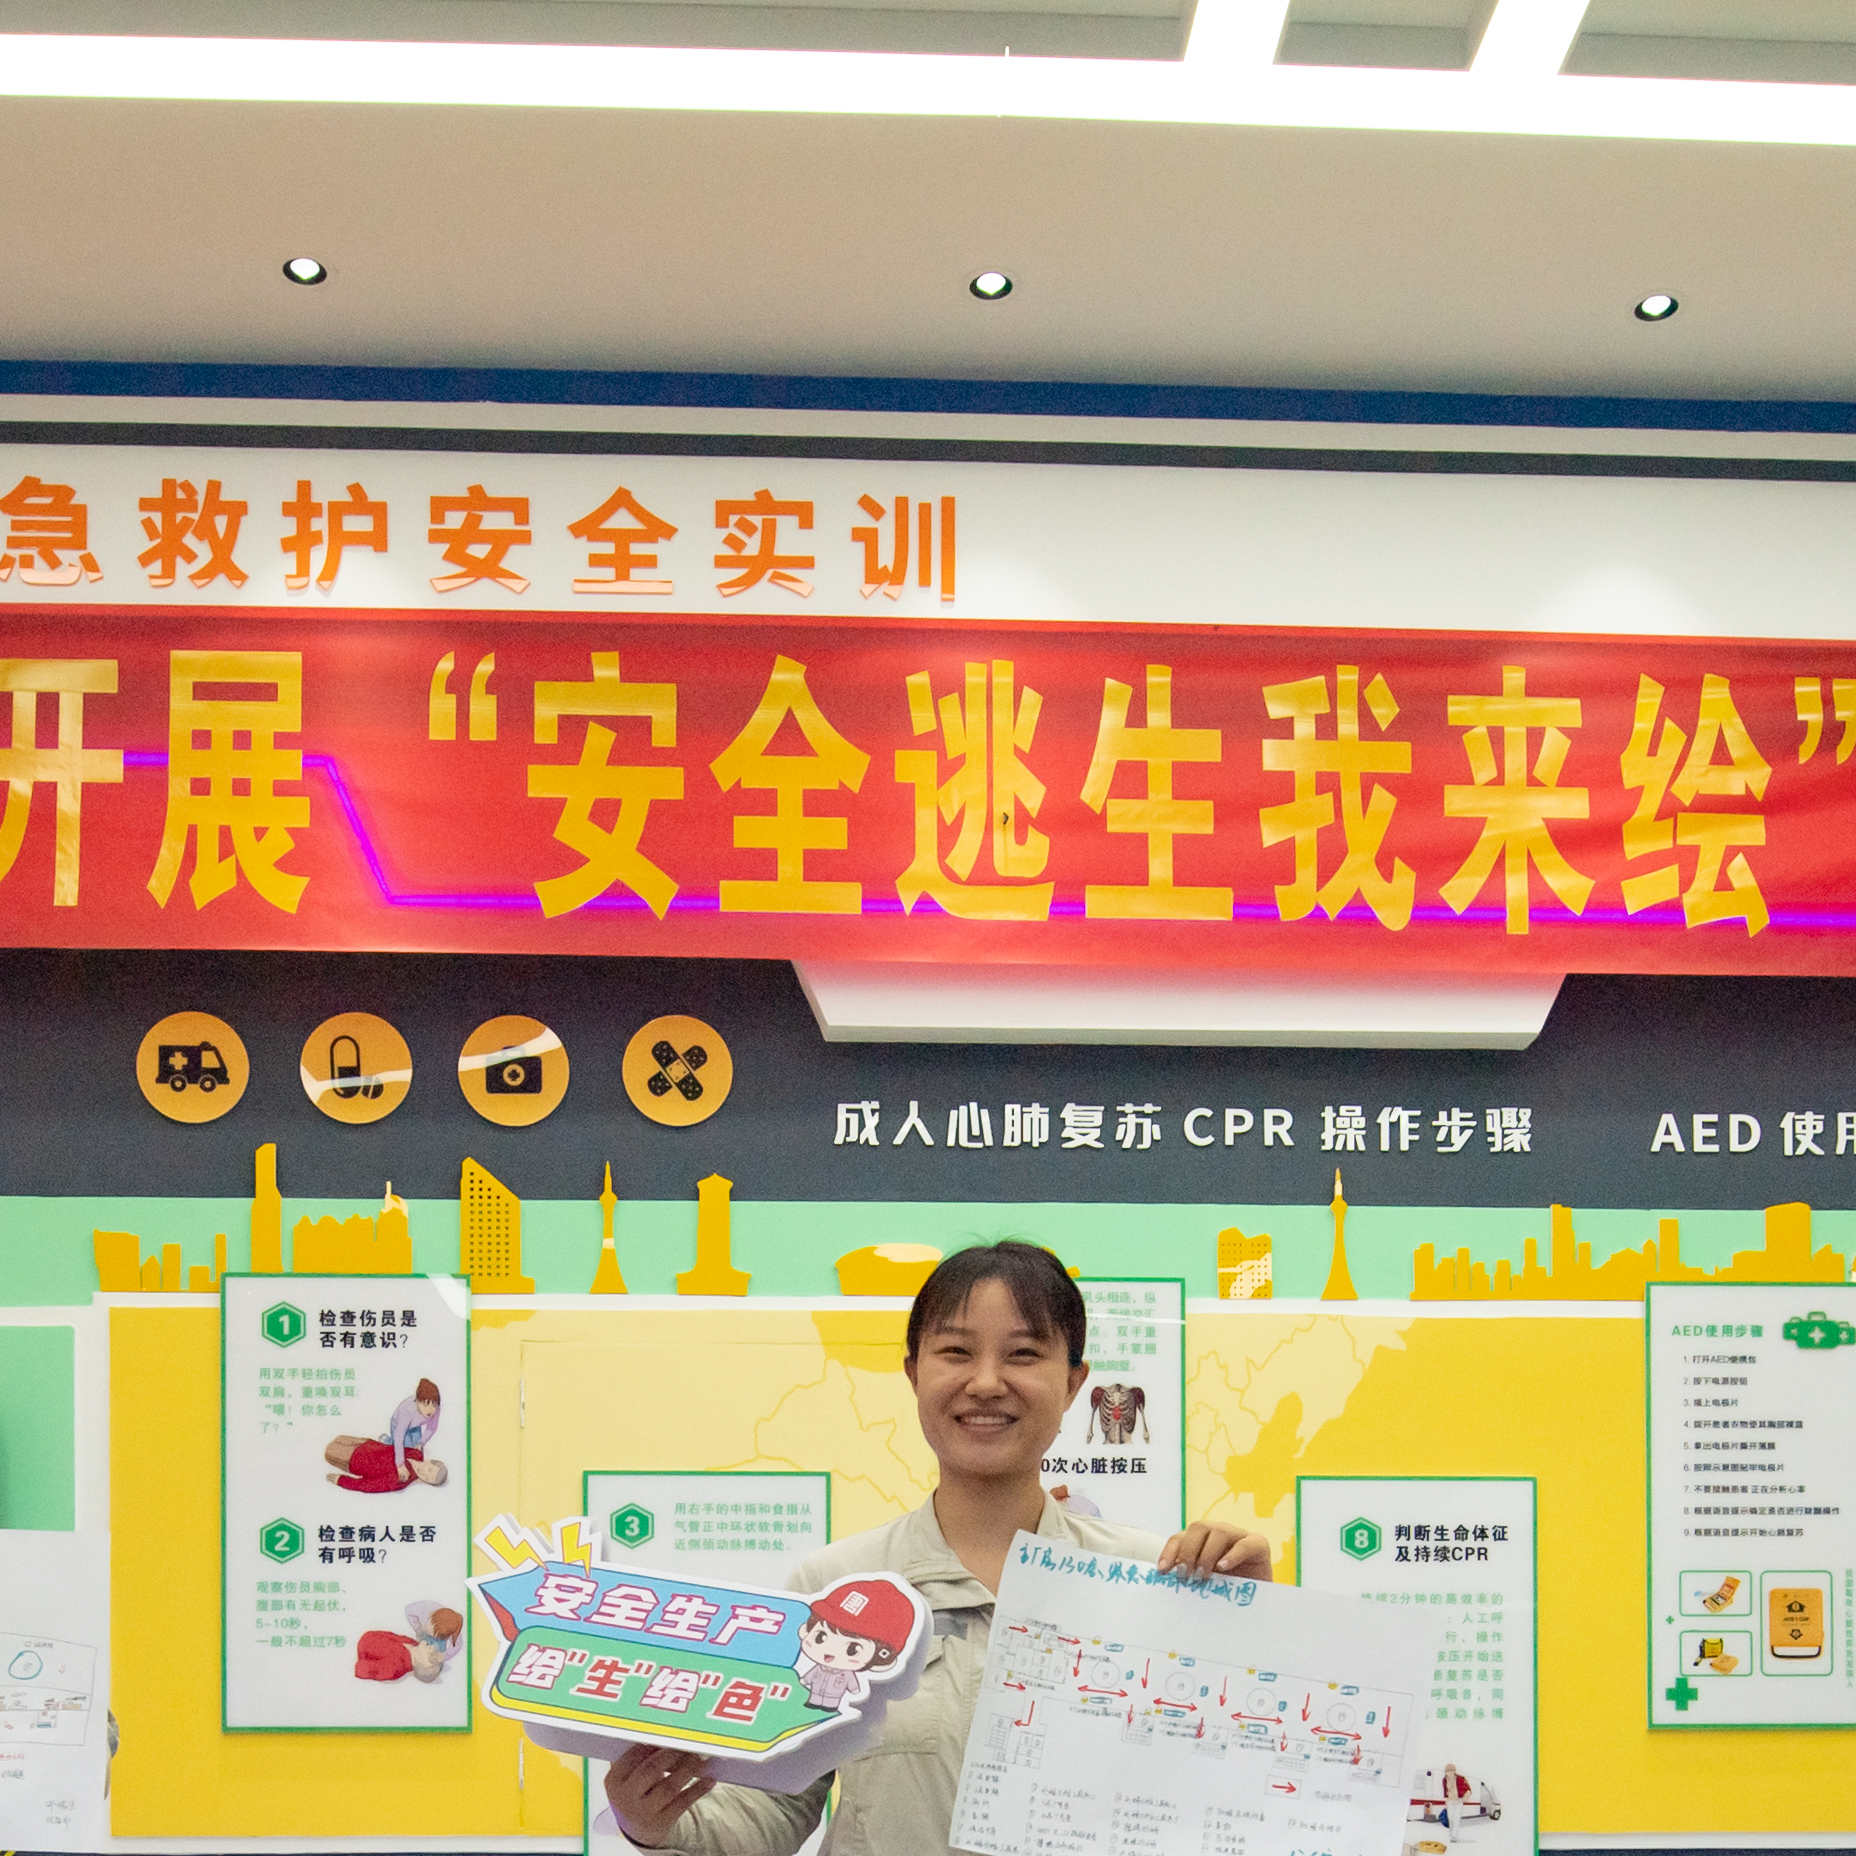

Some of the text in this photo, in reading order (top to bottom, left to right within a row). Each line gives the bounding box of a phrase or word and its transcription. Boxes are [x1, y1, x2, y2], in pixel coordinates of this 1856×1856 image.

[834, 1101, 1533, 1153] 成人心肺复苏 CPR 操作步骤
[1651, 1113, 1762, 1154] AED
[279, 1313, 290, 1336] 1
[319, 1309, 418, 1328] 检查伤员是
[318, 1525, 437, 1543] 检查病人是否
[624, 1515, 640, 1537] 3
[1395, 1524, 1509, 1542] 判断生命体征
[274, 1530, 291, 1551] 2
[1354, 1528, 1370, 1549] 8
[1395, 1545, 1489, 1563] 及持续CPR
[525, 1573, 786, 1645] 安全生产
